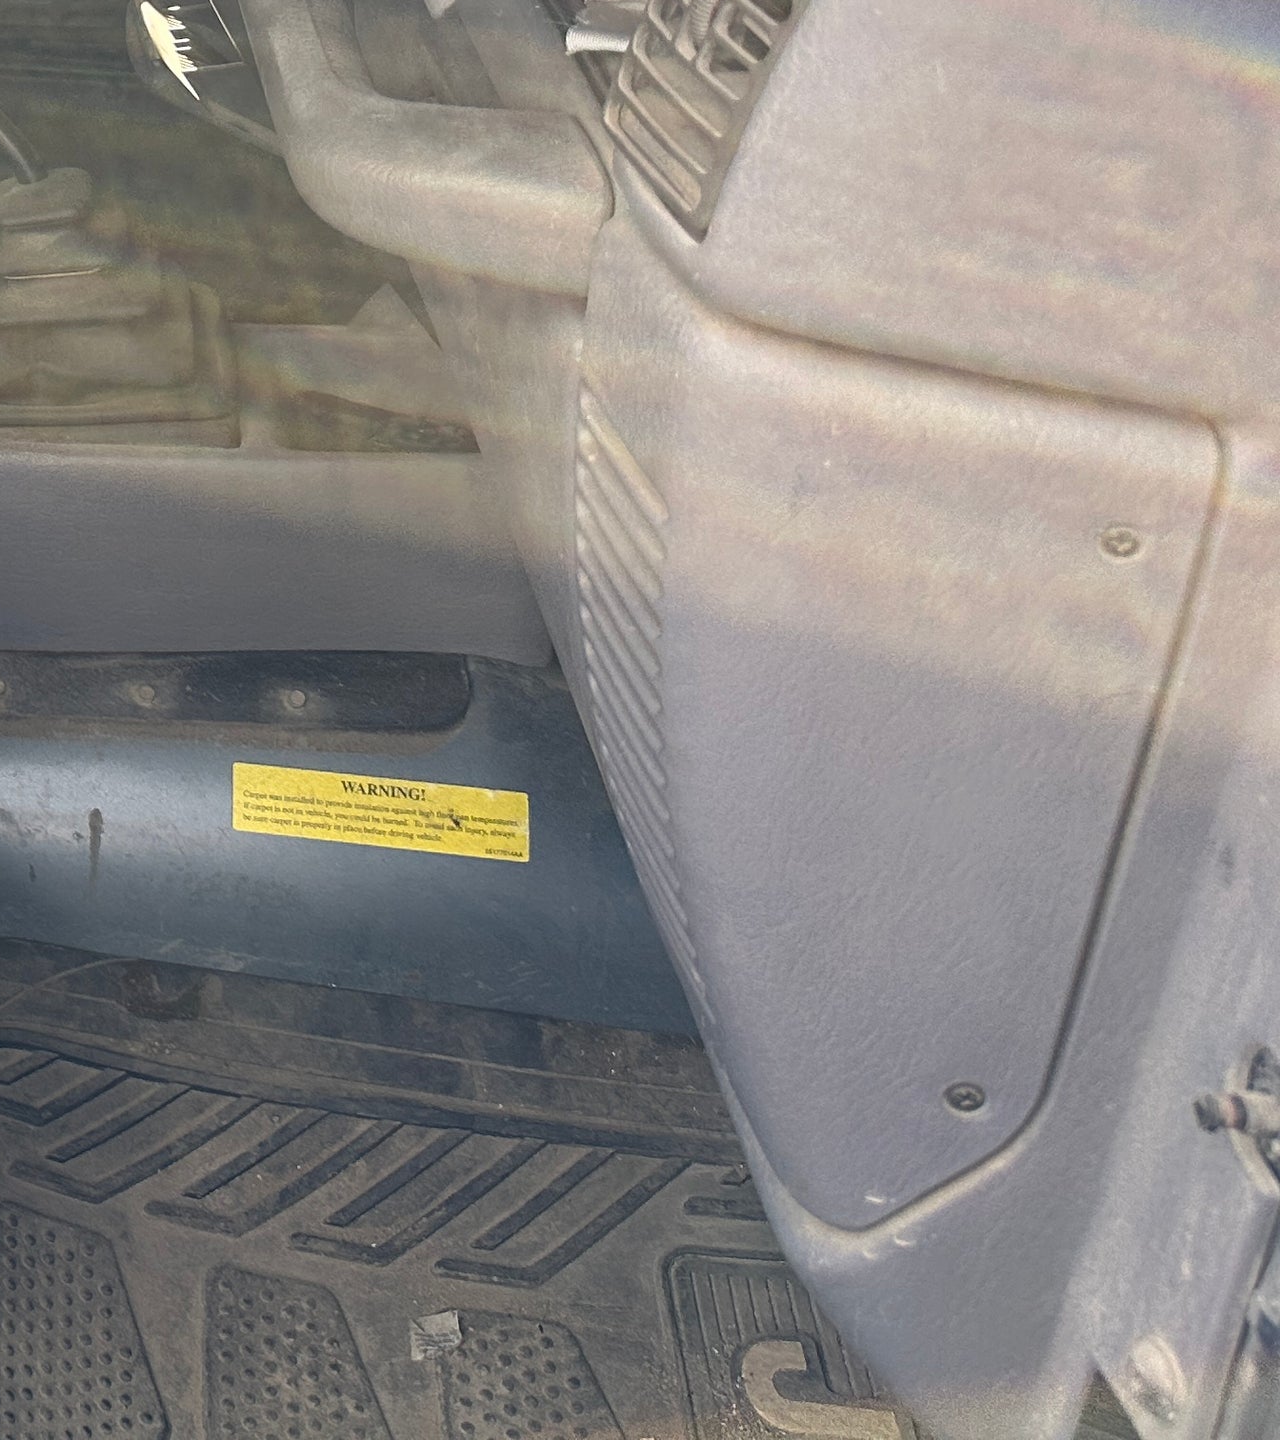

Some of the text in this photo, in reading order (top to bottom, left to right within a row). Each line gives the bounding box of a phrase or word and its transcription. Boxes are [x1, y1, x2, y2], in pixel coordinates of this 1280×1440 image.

[243, 789, 267, 800] Carpet
[283, 794, 314, 804] installed
[341, 780, 425, 801] WARNING!
[251, 803, 272, 812] carpet
[269, 817, 291, 826] carpet
[301, 819, 331, 830] properly
[388, 829, 413, 839] driving
